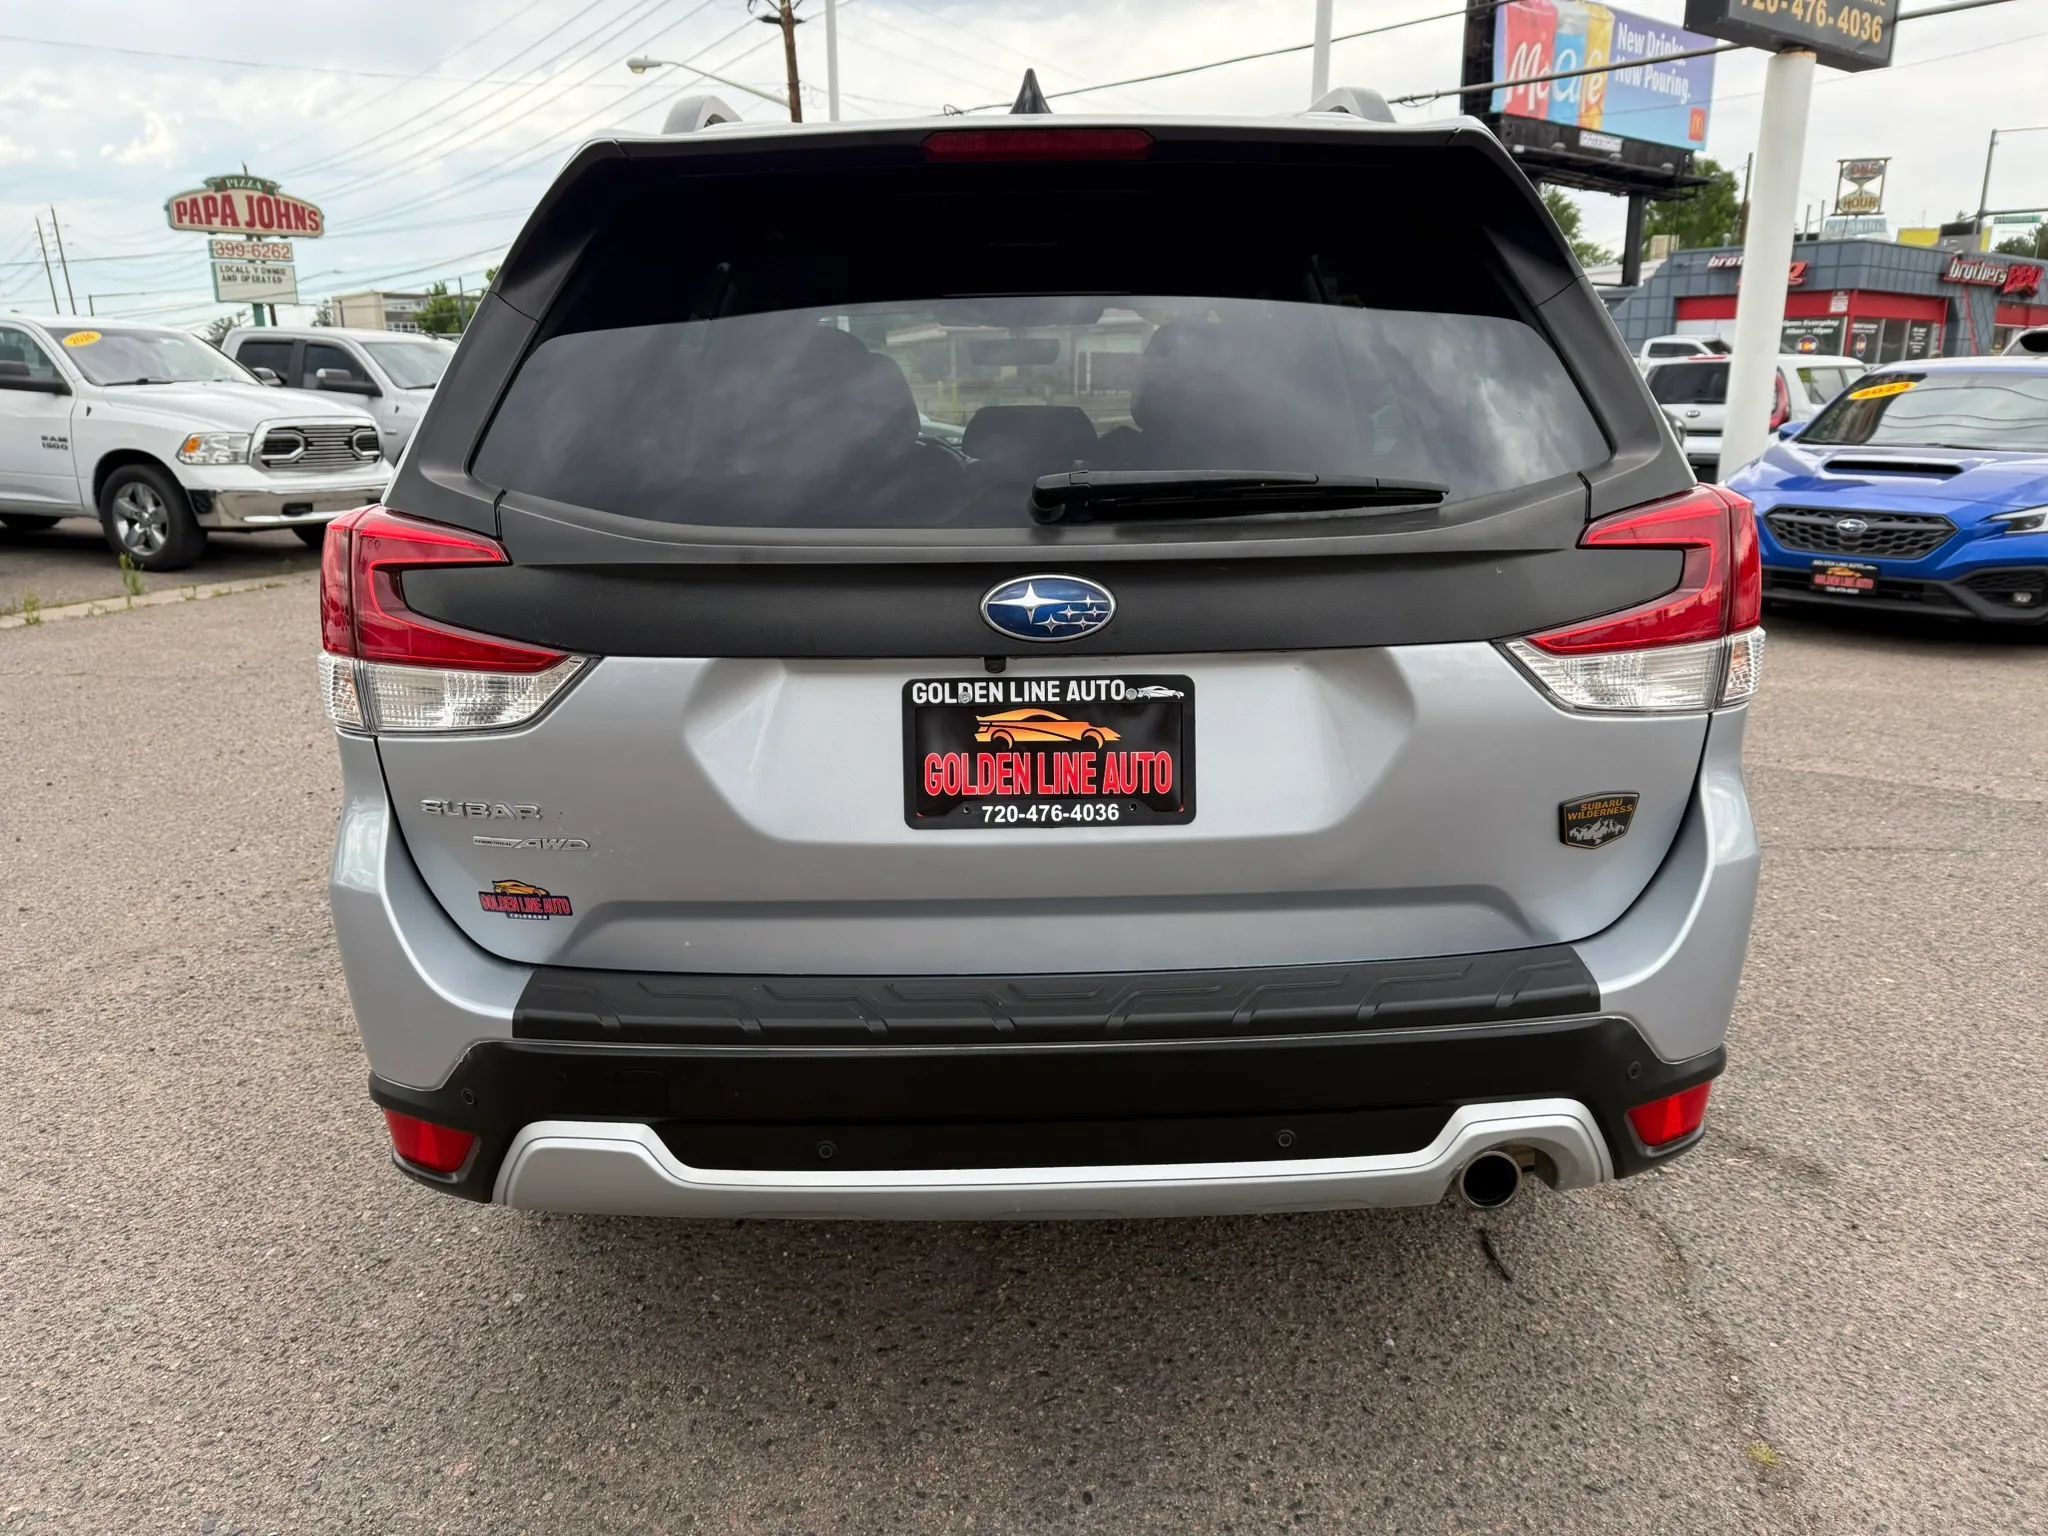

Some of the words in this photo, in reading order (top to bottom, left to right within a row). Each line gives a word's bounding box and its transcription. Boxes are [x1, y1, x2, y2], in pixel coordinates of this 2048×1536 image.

[1741, 0, 1882, 43] 0-476-4036
[1617, 22, 1645, 55] New
[1615, 54, 1643, 87] Now
[1644, 63, 1691, 105] Pouring.
[1852, 163, 1878, 176] ONE
[225, 178, 263, 190] PIZZA
[174, 194, 240, 227] PAPA
[1843, 197, 1877, 209] HOUR
[214, 241, 291, 259] 399-6262
[221, 275, 238, 283] AND
[41, 434, 68, 443] RAM
[42, 442, 69, 451] 1500
[912, 682, 1003, 703] GOLDEN
[1010, 681, 1060, 702] LINE
[1066, 679, 1125, 701] AUTO
[924, 752, 1031, 796] GOLDEN
[1037, 752, 1097, 795] LINE
[1102, 750, 1173, 795] AUTO
[421, 799, 543, 819] SUBAR
[981, 804, 1120, 823] 720-476-4036
[1567, 805, 1633, 820] WILDERNESS
[1580, 799, 1623, 812] SUBARU
[514, 838, 590, 850] AWD
[480, 894, 519, 912] GOLDEN
[519, 896, 544, 913] LINE
[543, 897, 572, 915] AUTO
